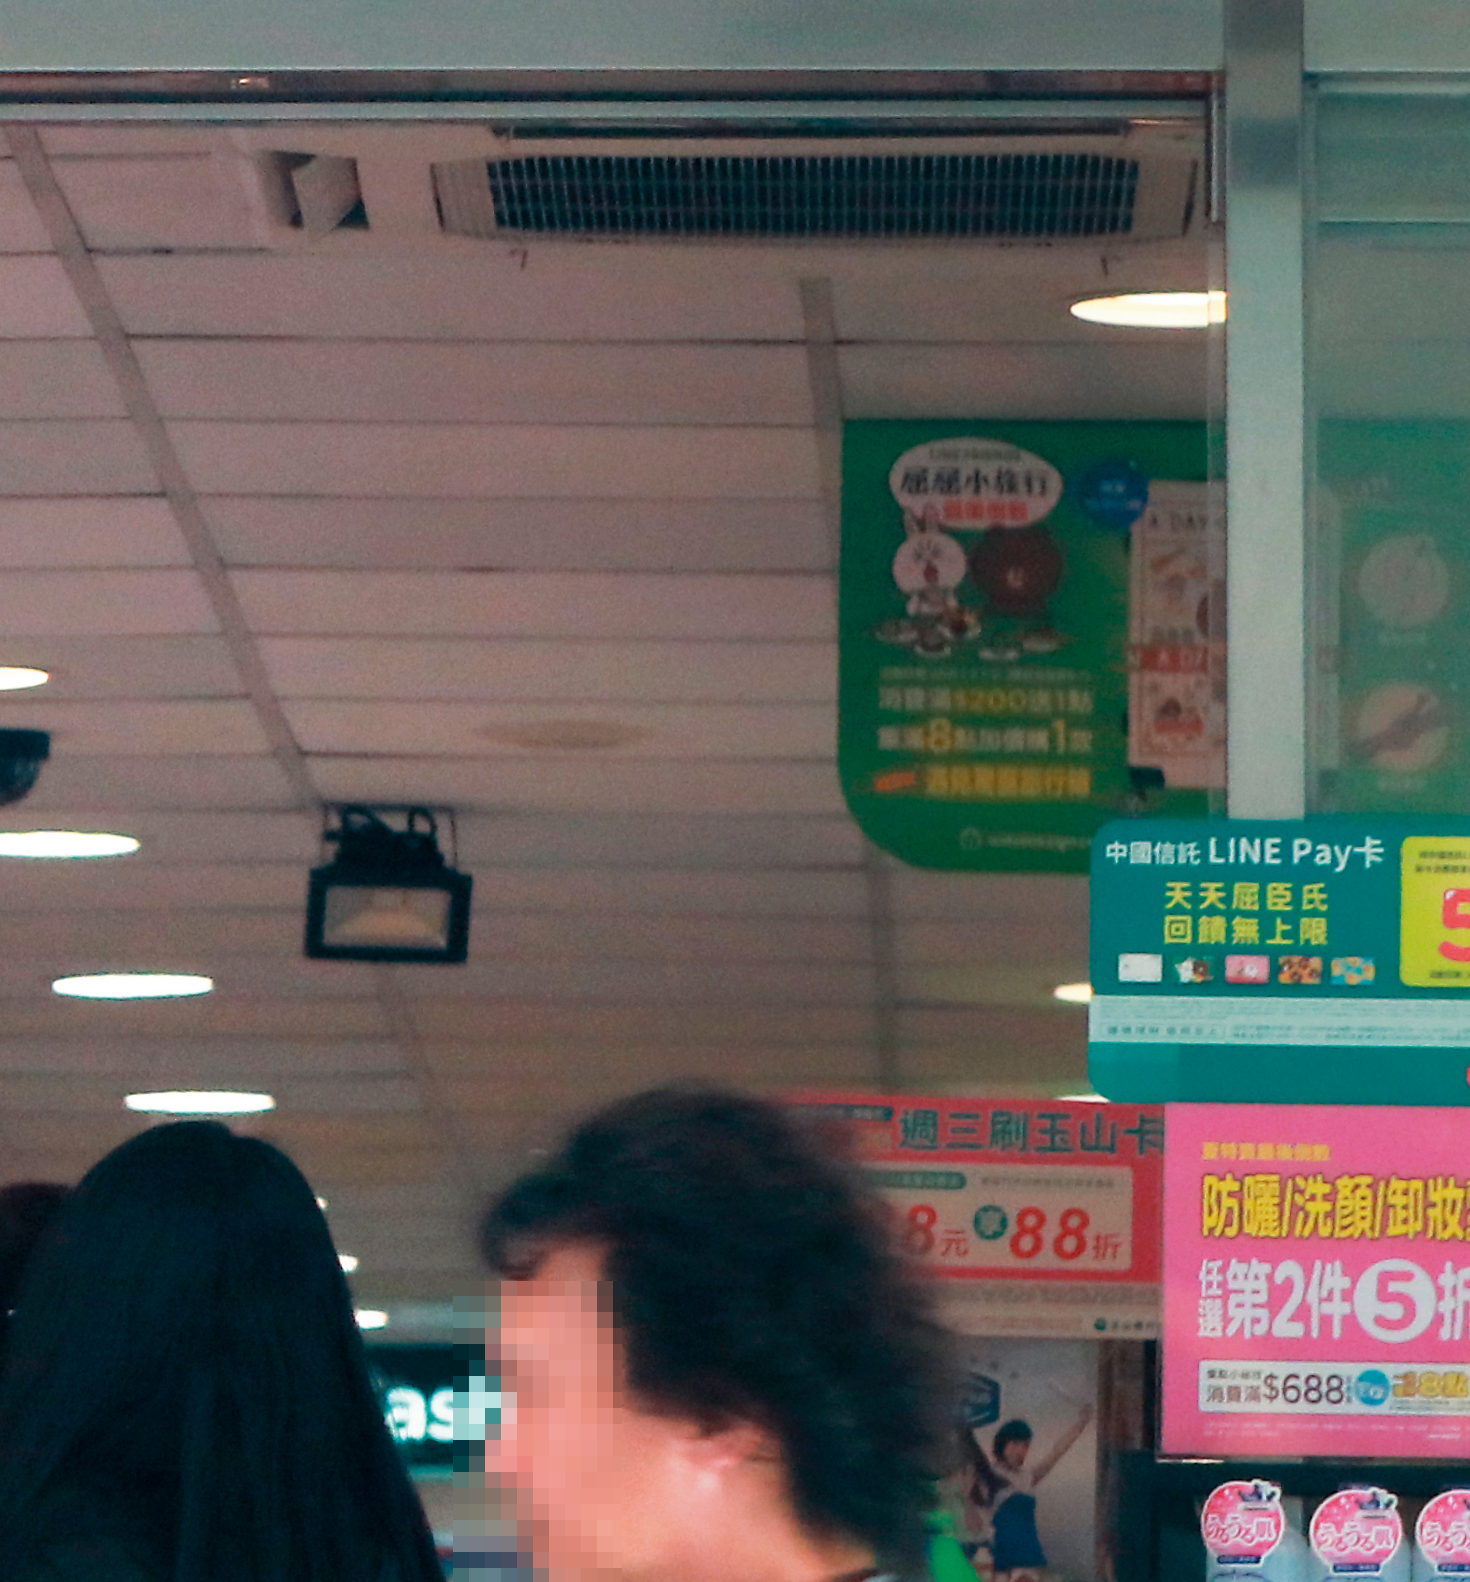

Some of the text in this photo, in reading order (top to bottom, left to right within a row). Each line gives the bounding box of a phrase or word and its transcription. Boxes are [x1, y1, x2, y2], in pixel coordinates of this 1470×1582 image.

[1106, 841, 1201, 866] 中國信託
[1209, 838, 1282, 865] LINE
[1292, 836, 1385, 873] Pay卡
[1164, 881, 1329, 912] 天天屈臣氏
[1164, 914, 1329, 946] 回饋無上限
[1201, 1173, 1470, 1242] 防曬/洗顏/卸妝
